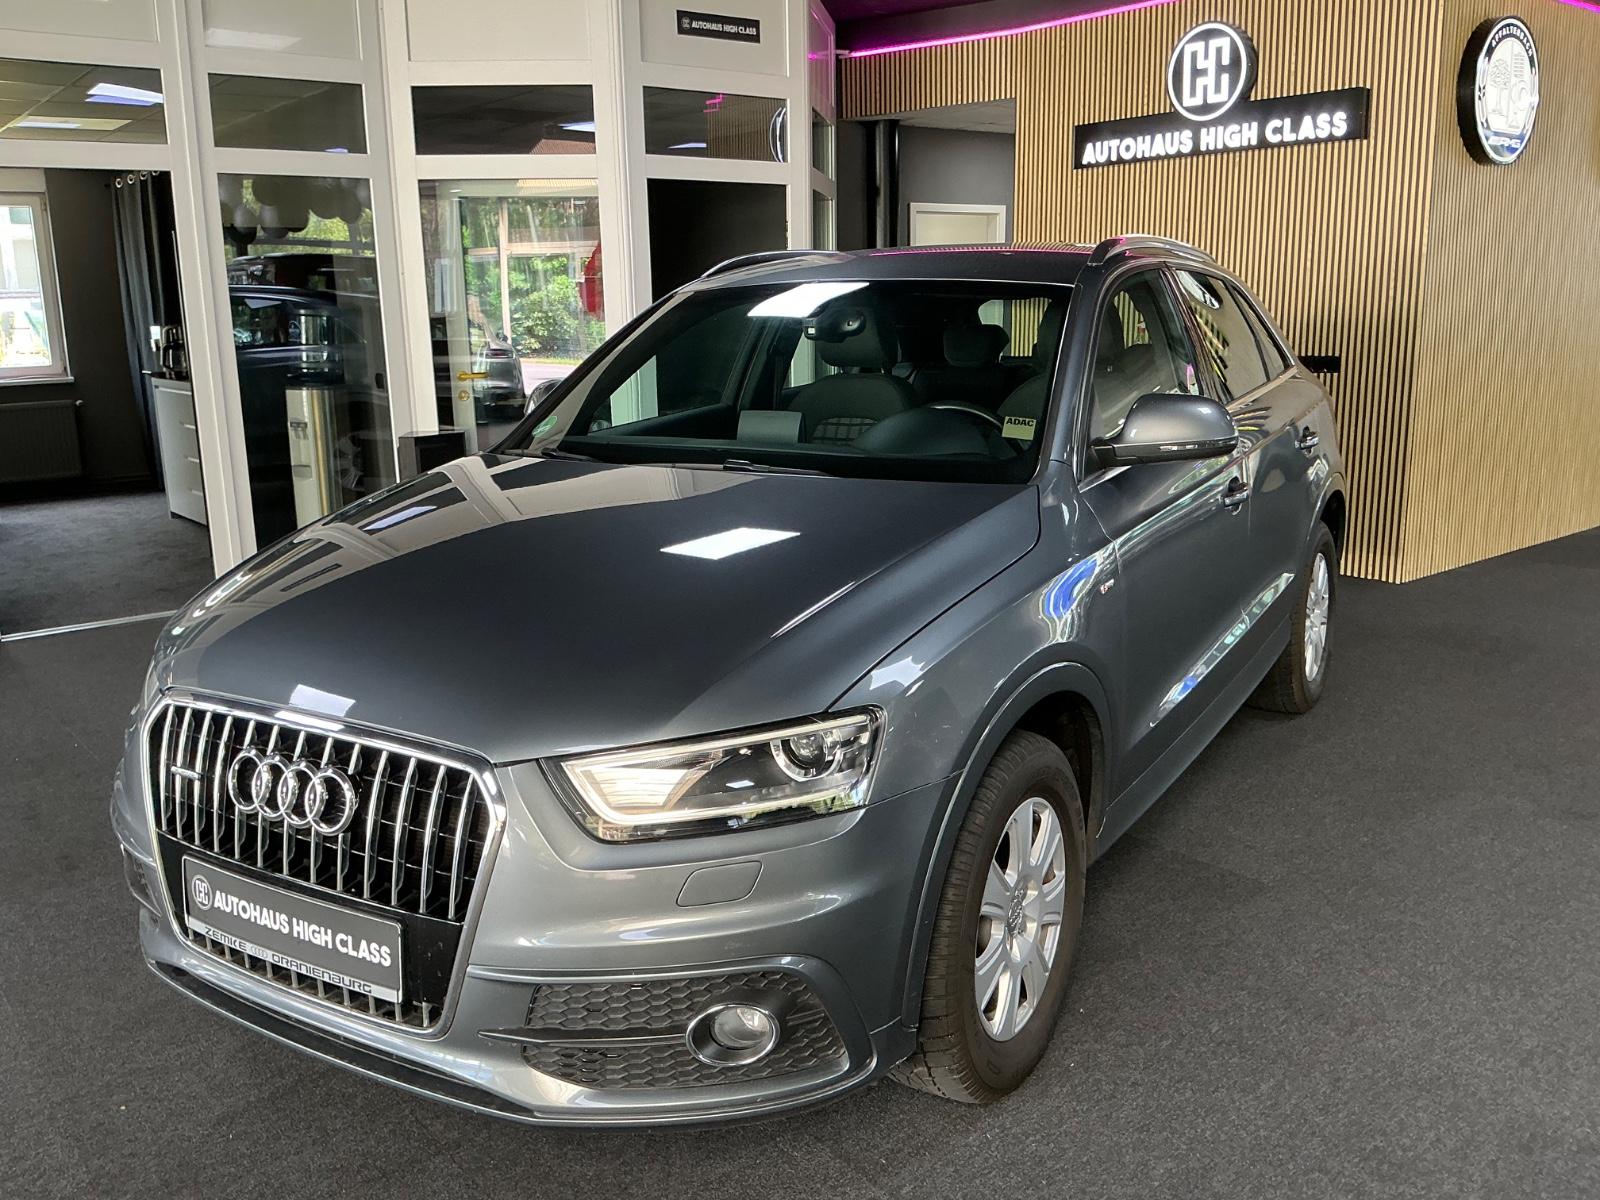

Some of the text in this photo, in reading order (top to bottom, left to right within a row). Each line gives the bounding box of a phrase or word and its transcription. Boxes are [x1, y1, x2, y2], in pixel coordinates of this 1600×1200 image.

[692, 20, 722, 31] AUTOHAUS
[723, 24, 738, 33] HIGH
[738, 25, 756, 35] CLASS
[1082, 111, 1347, 165] AUTOHAUS HIGH CLASS
[1006, 418, 1034, 427] ADAC
[214, 890, 391, 967] AUTOHAUS HIGH CLASS
[204, 926, 372, 994] ZEMKE ORANIENBURG
